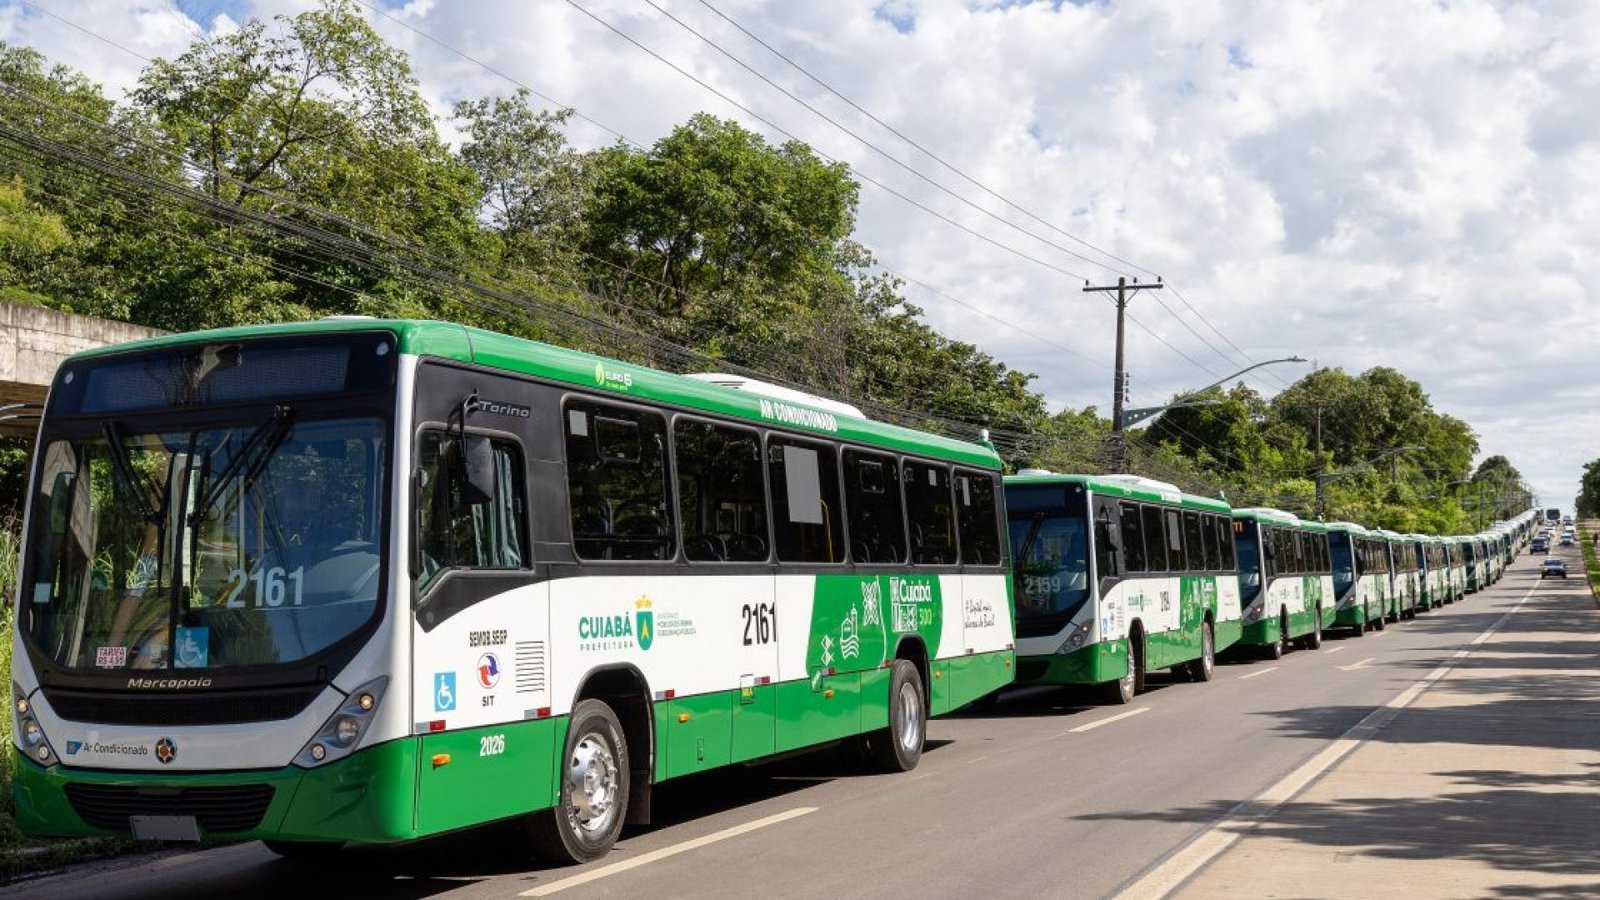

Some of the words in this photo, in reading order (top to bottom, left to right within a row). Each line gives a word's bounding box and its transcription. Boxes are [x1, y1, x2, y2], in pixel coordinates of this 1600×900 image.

[480, 401, 529, 417] Torino
[760, 400, 774, 419] AR
[774, 402, 838, 432] CONDICIONADO
[226, 566, 304, 608] 2161
[900, 579, 932, 602] Cuiabá
[579, 611, 633, 639] CUIABÁ
[743, 602, 776, 646] 2161
[99, 648, 125, 656] TARIFA
[580, 641, 633, 651] PREFEITURA
[127, 677, 213, 689] Marcopolo
[482, 696, 495, 707] SIT
[83, 741, 93, 752] Ar
[94, 742, 148, 755] Condicionado
[480, 734, 505, 756] 2026
